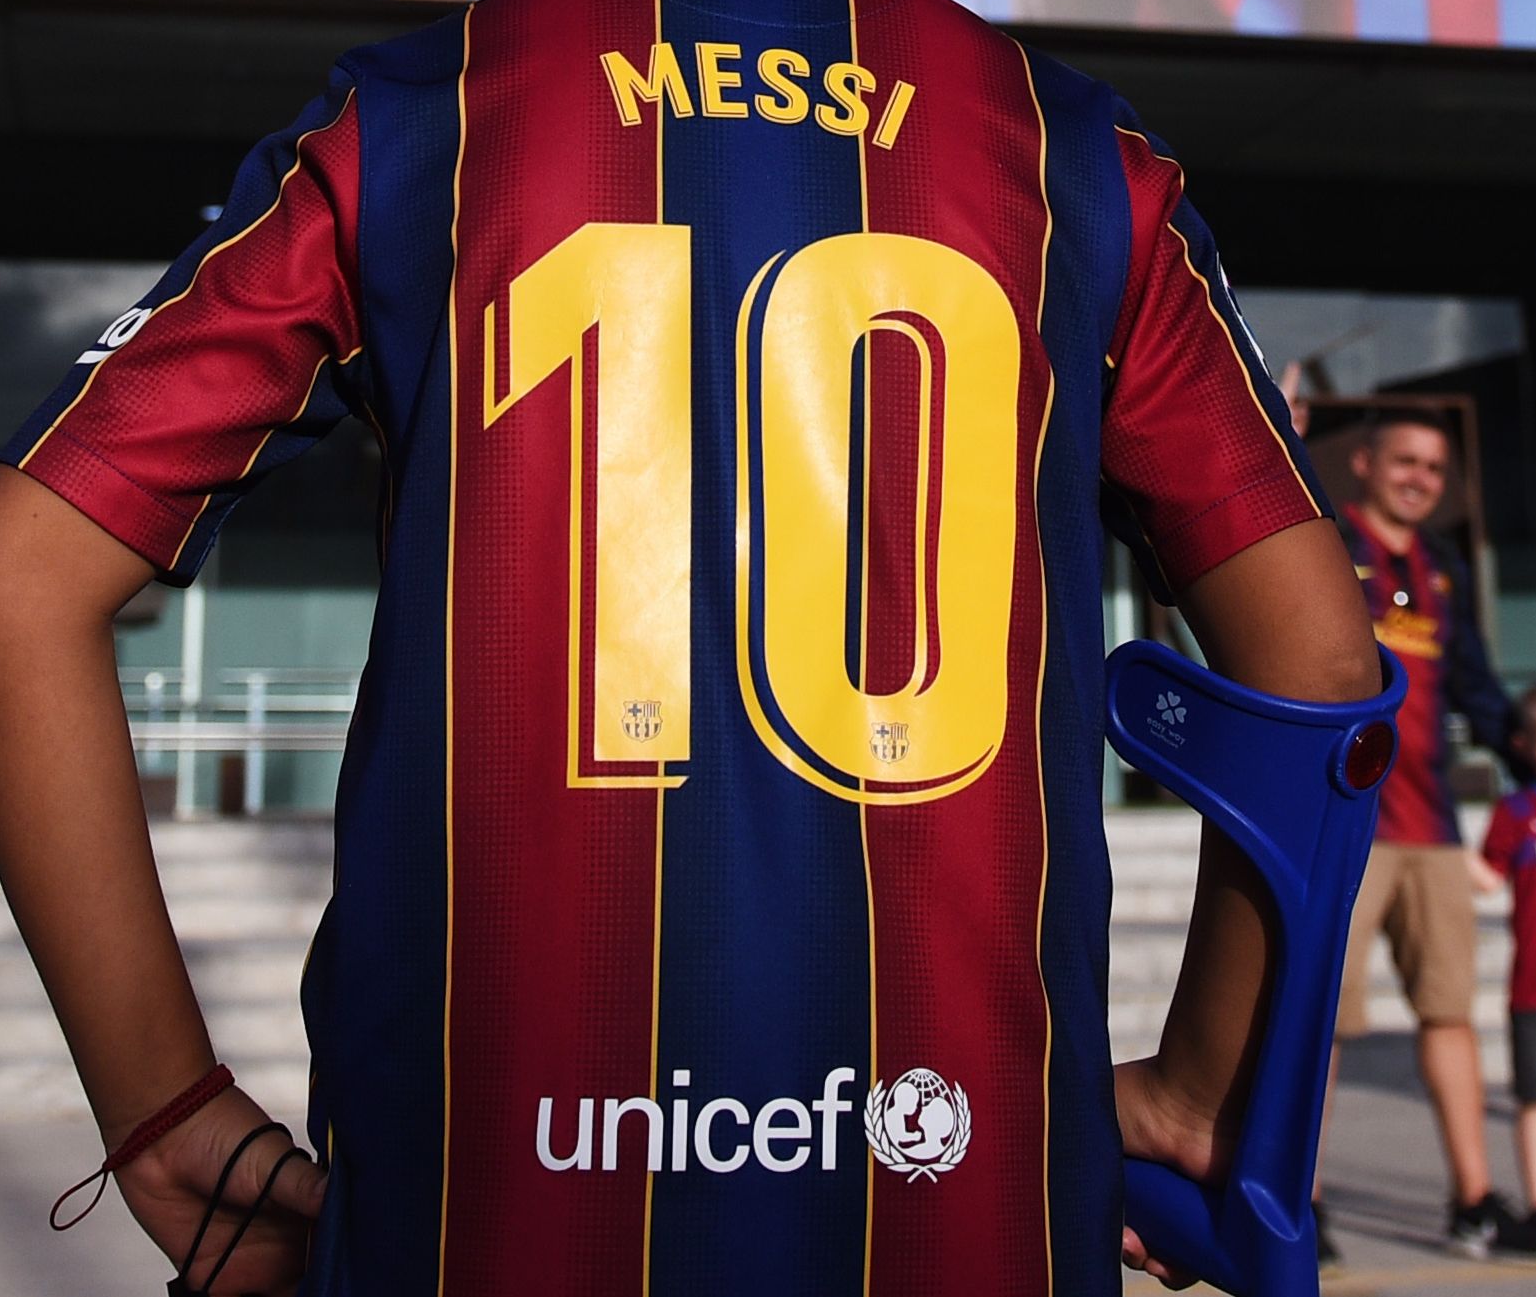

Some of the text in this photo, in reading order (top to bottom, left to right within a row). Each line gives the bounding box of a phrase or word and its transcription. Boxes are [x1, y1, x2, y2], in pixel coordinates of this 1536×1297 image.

[599, 42, 916, 150] MESSI
[484, 222, 1021, 805] 10
[535, 1066, 856, 1173] unicef
